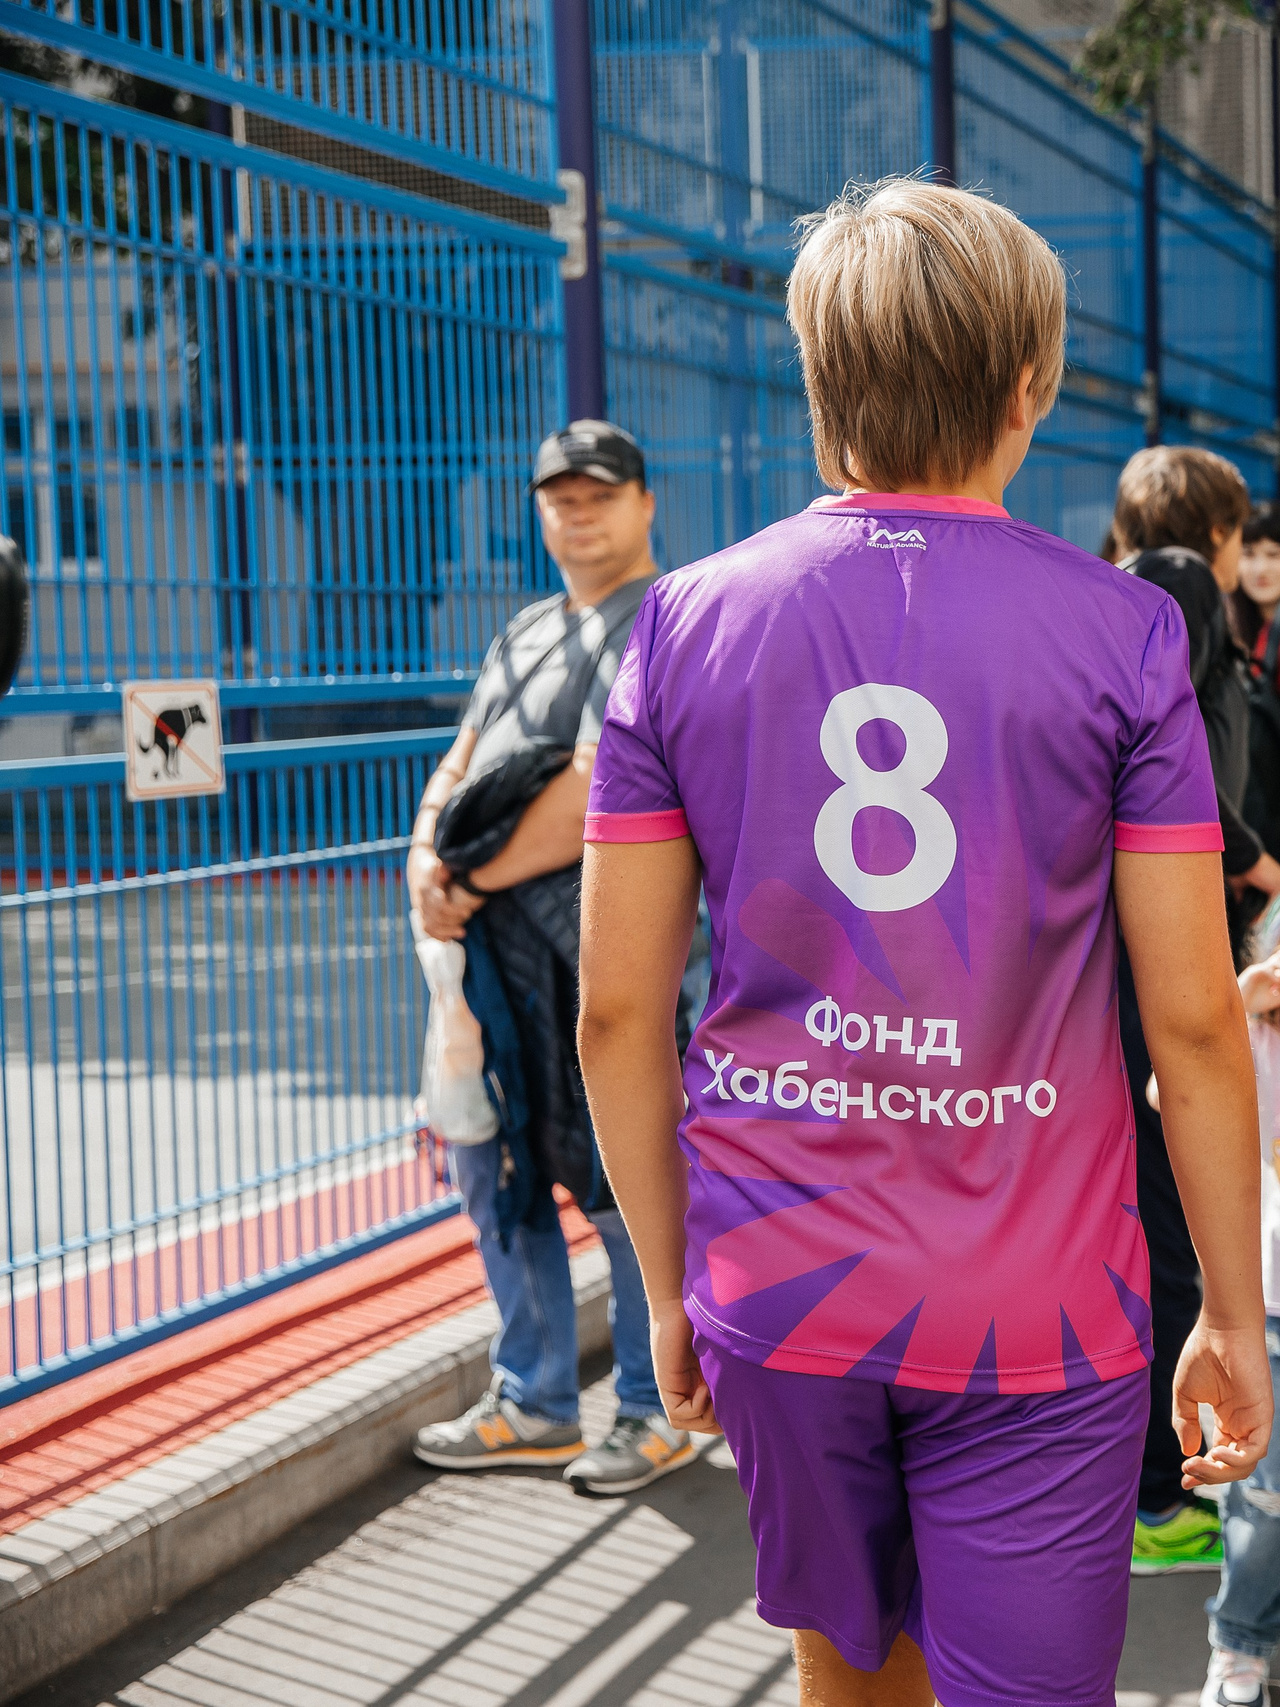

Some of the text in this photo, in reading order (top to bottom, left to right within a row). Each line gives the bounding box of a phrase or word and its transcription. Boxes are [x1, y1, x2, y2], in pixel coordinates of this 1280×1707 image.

[814, 682, 957, 912] 8
[805, 995, 962, 1066] Фонд
[701, 1048, 1058, 1127] Хабенского
